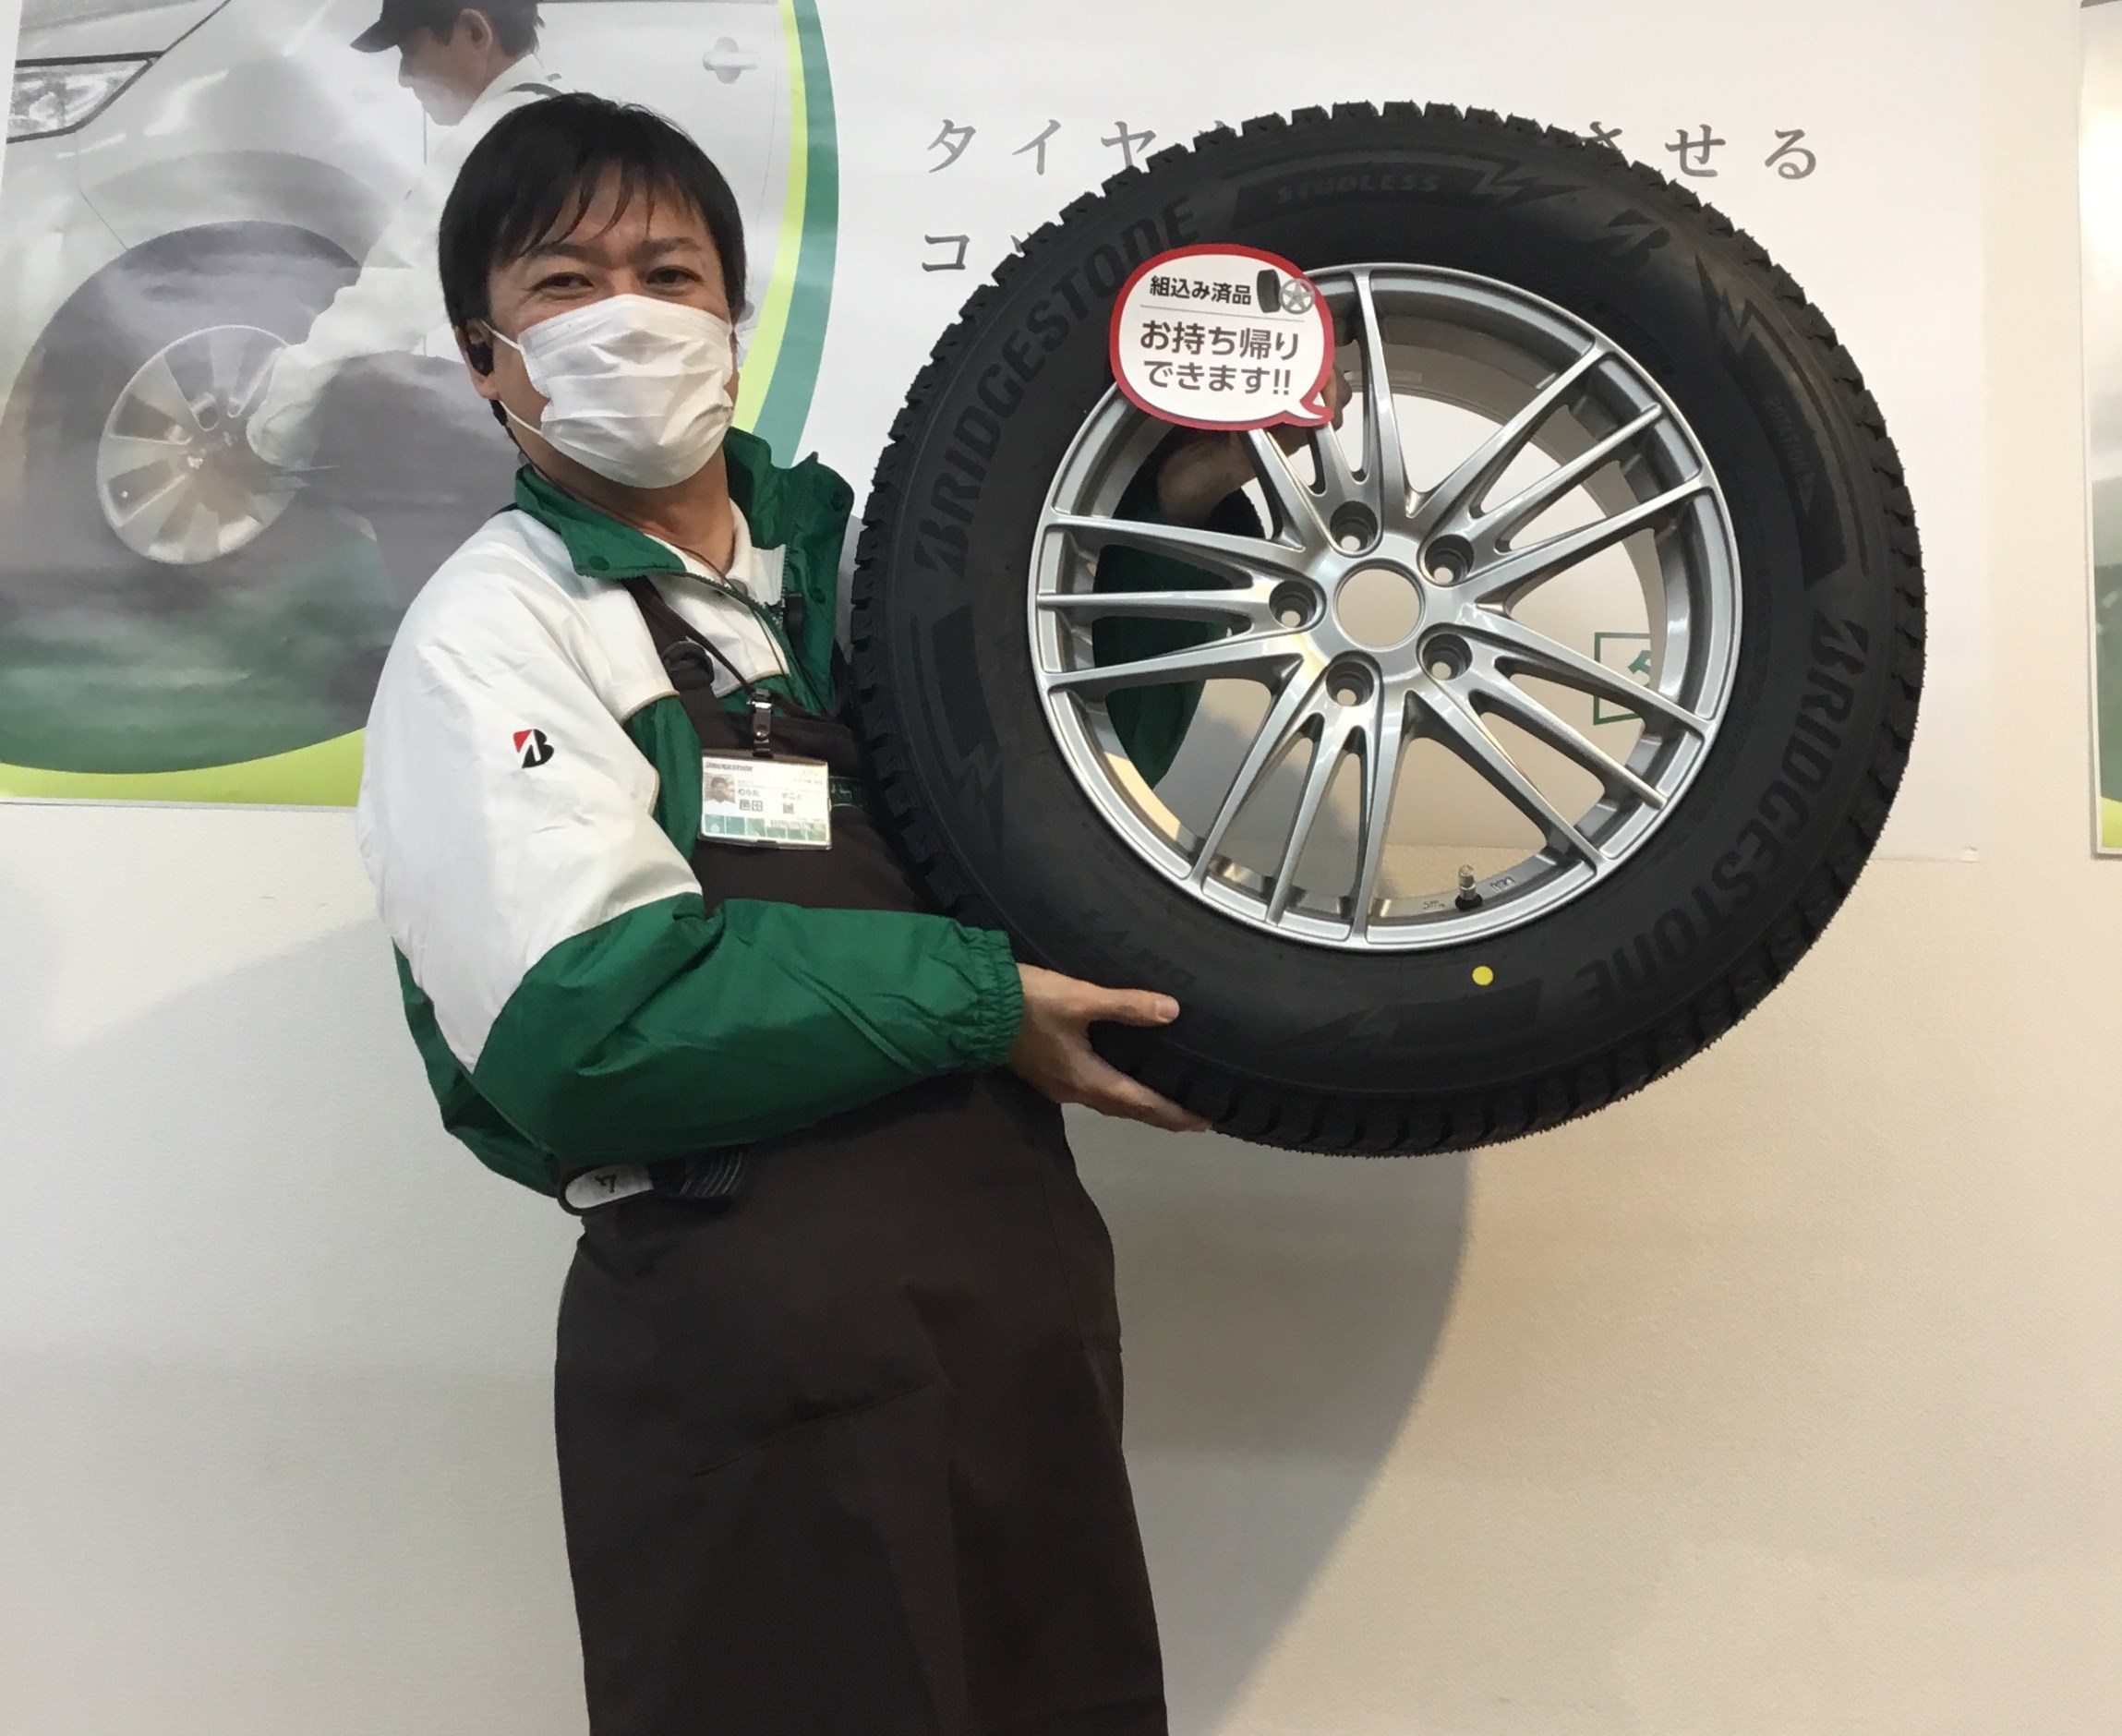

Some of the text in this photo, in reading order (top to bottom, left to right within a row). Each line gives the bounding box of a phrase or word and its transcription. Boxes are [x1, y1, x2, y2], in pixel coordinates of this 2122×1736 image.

[1150, 274, 1251, 306] 組込み済品
[1139, 319, 1299, 361] お持ち帰り
[1143, 360, 1292, 395] できます!!
